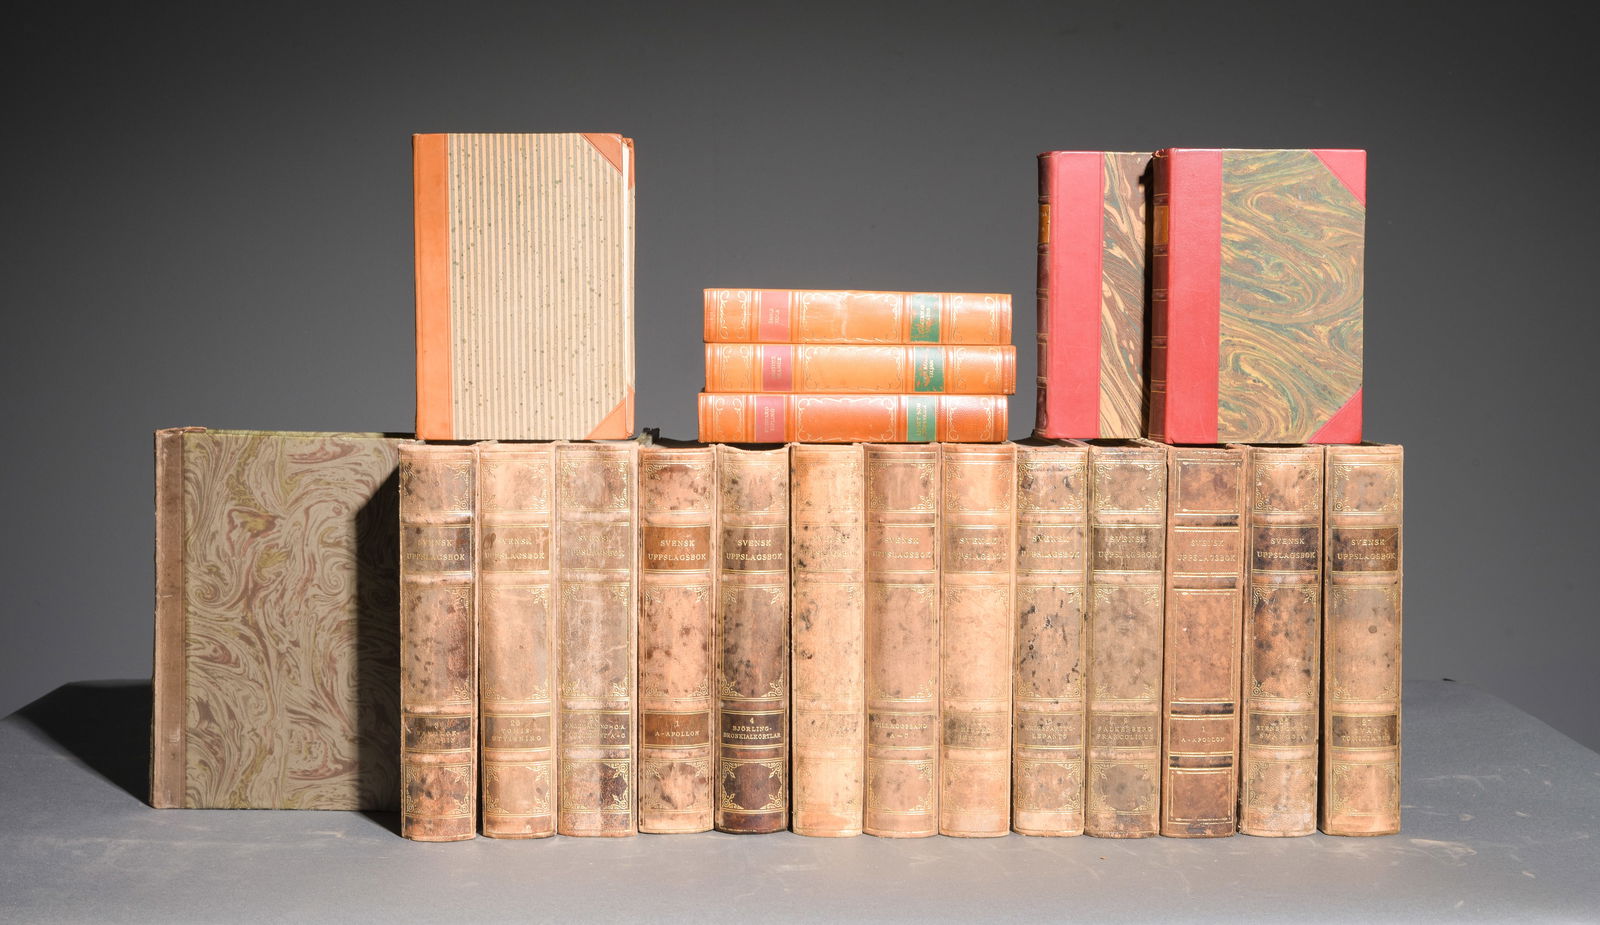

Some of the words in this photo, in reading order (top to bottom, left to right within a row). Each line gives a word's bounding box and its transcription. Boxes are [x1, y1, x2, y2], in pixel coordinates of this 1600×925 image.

[660, 539, 696, 547] SVENSK
[737, 539, 772, 547] SVENSK
[1270, 537, 1305, 545] SVENSK
[1350, 538, 1385, 546] SVENSK
[648, 553, 707, 561] UPPSLAGSBOK
[726, 552, 783, 561] UPPSLAGSBOK
[1177, 553, 1236, 562] UPPSLAGSBOK
[1256, 551, 1316, 559] UPPSLAGSBOK
[1336, 552, 1397, 560] UPPSLAGSBOK
